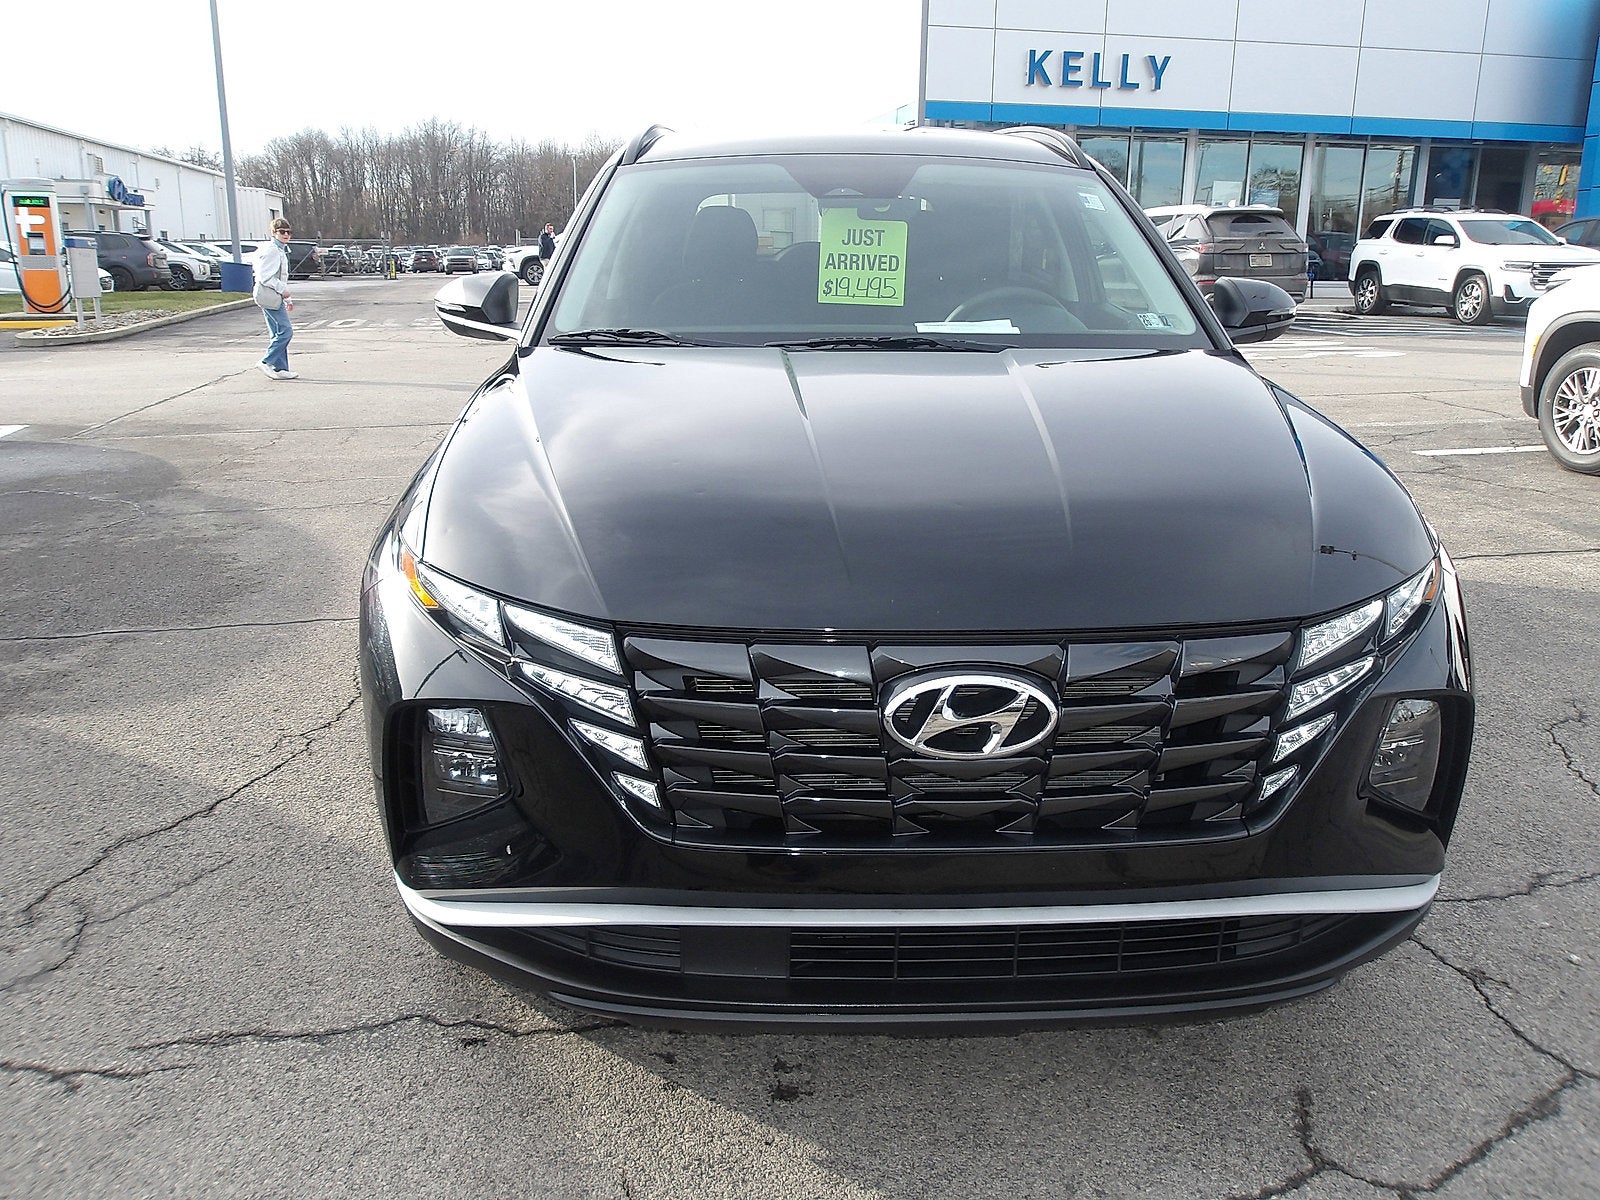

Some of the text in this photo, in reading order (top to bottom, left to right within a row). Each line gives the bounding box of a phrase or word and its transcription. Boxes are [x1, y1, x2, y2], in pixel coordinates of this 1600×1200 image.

[1026, 49, 1172, 91] KELLY
[842, 229, 885, 247] JUST
[824, 253, 900, 272] ARRIVED
[822, 277, 898, 299] $19,495
